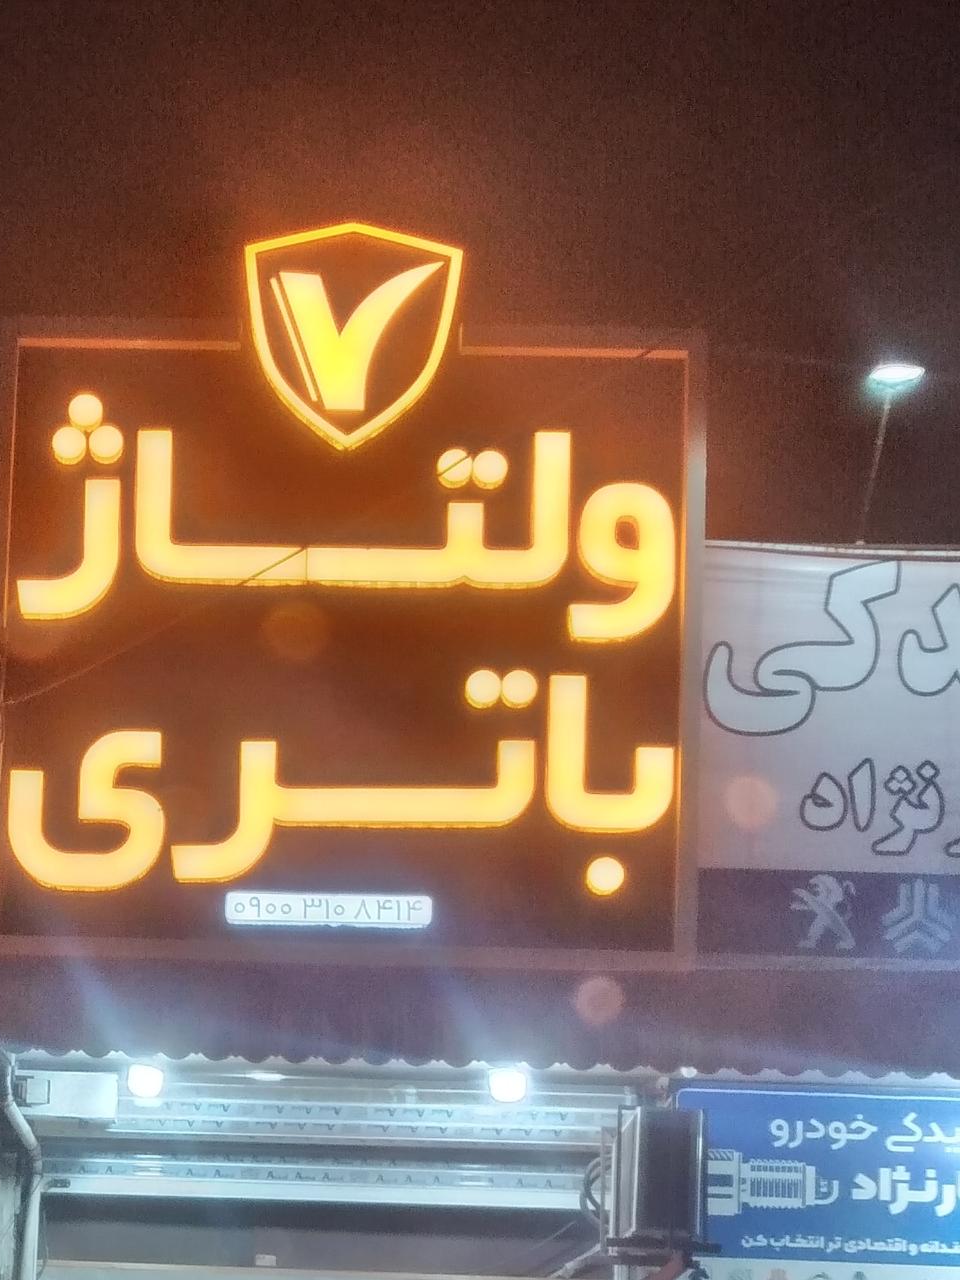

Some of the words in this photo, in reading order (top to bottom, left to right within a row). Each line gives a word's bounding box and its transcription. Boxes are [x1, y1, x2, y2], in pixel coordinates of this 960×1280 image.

[16, 393, 677, 643] ولتاژ
[704, 558, 960, 737] دکی
[7, 668, 675, 896] باتری
[769, 1113, 879, 1150] خودرو
[740, 1233, 769, 1249] کن
[769, 1234, 825, 1252] انتخاب
[826, 1236, 842, 1253] تر
[843, 1236, 907, 1254] اقتصادی
